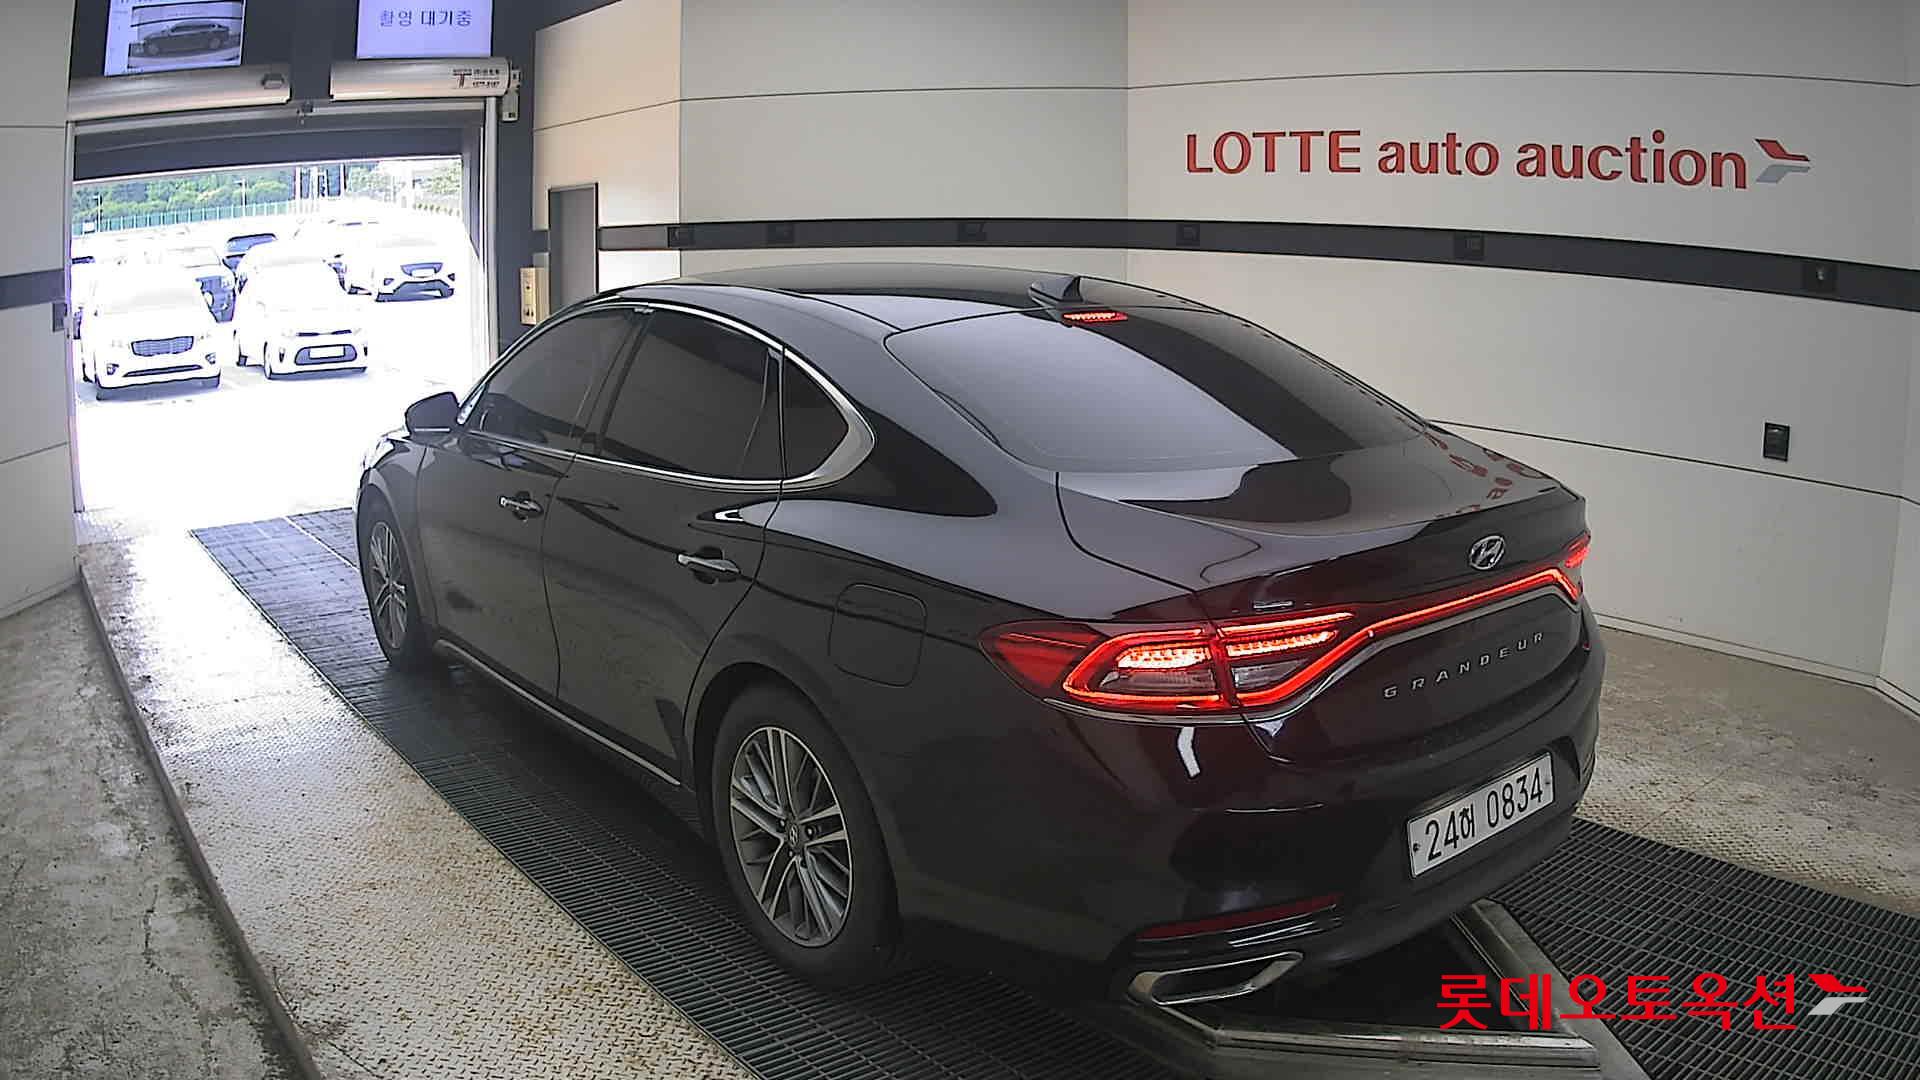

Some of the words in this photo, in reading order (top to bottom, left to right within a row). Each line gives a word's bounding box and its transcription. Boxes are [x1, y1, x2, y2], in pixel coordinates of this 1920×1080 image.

[421, 9, 473, 28] 대기중
[1186, 129, 1361, 174] LOTTE
[1377, 131, 1500, 178] auto
[1516, 129, 1748, 190] auction
[1383, 631, 1545, 699] GRANDEUR
[1424, 802, 1476, 863] 24허
[1486, 767, 1544, 829] 0834
